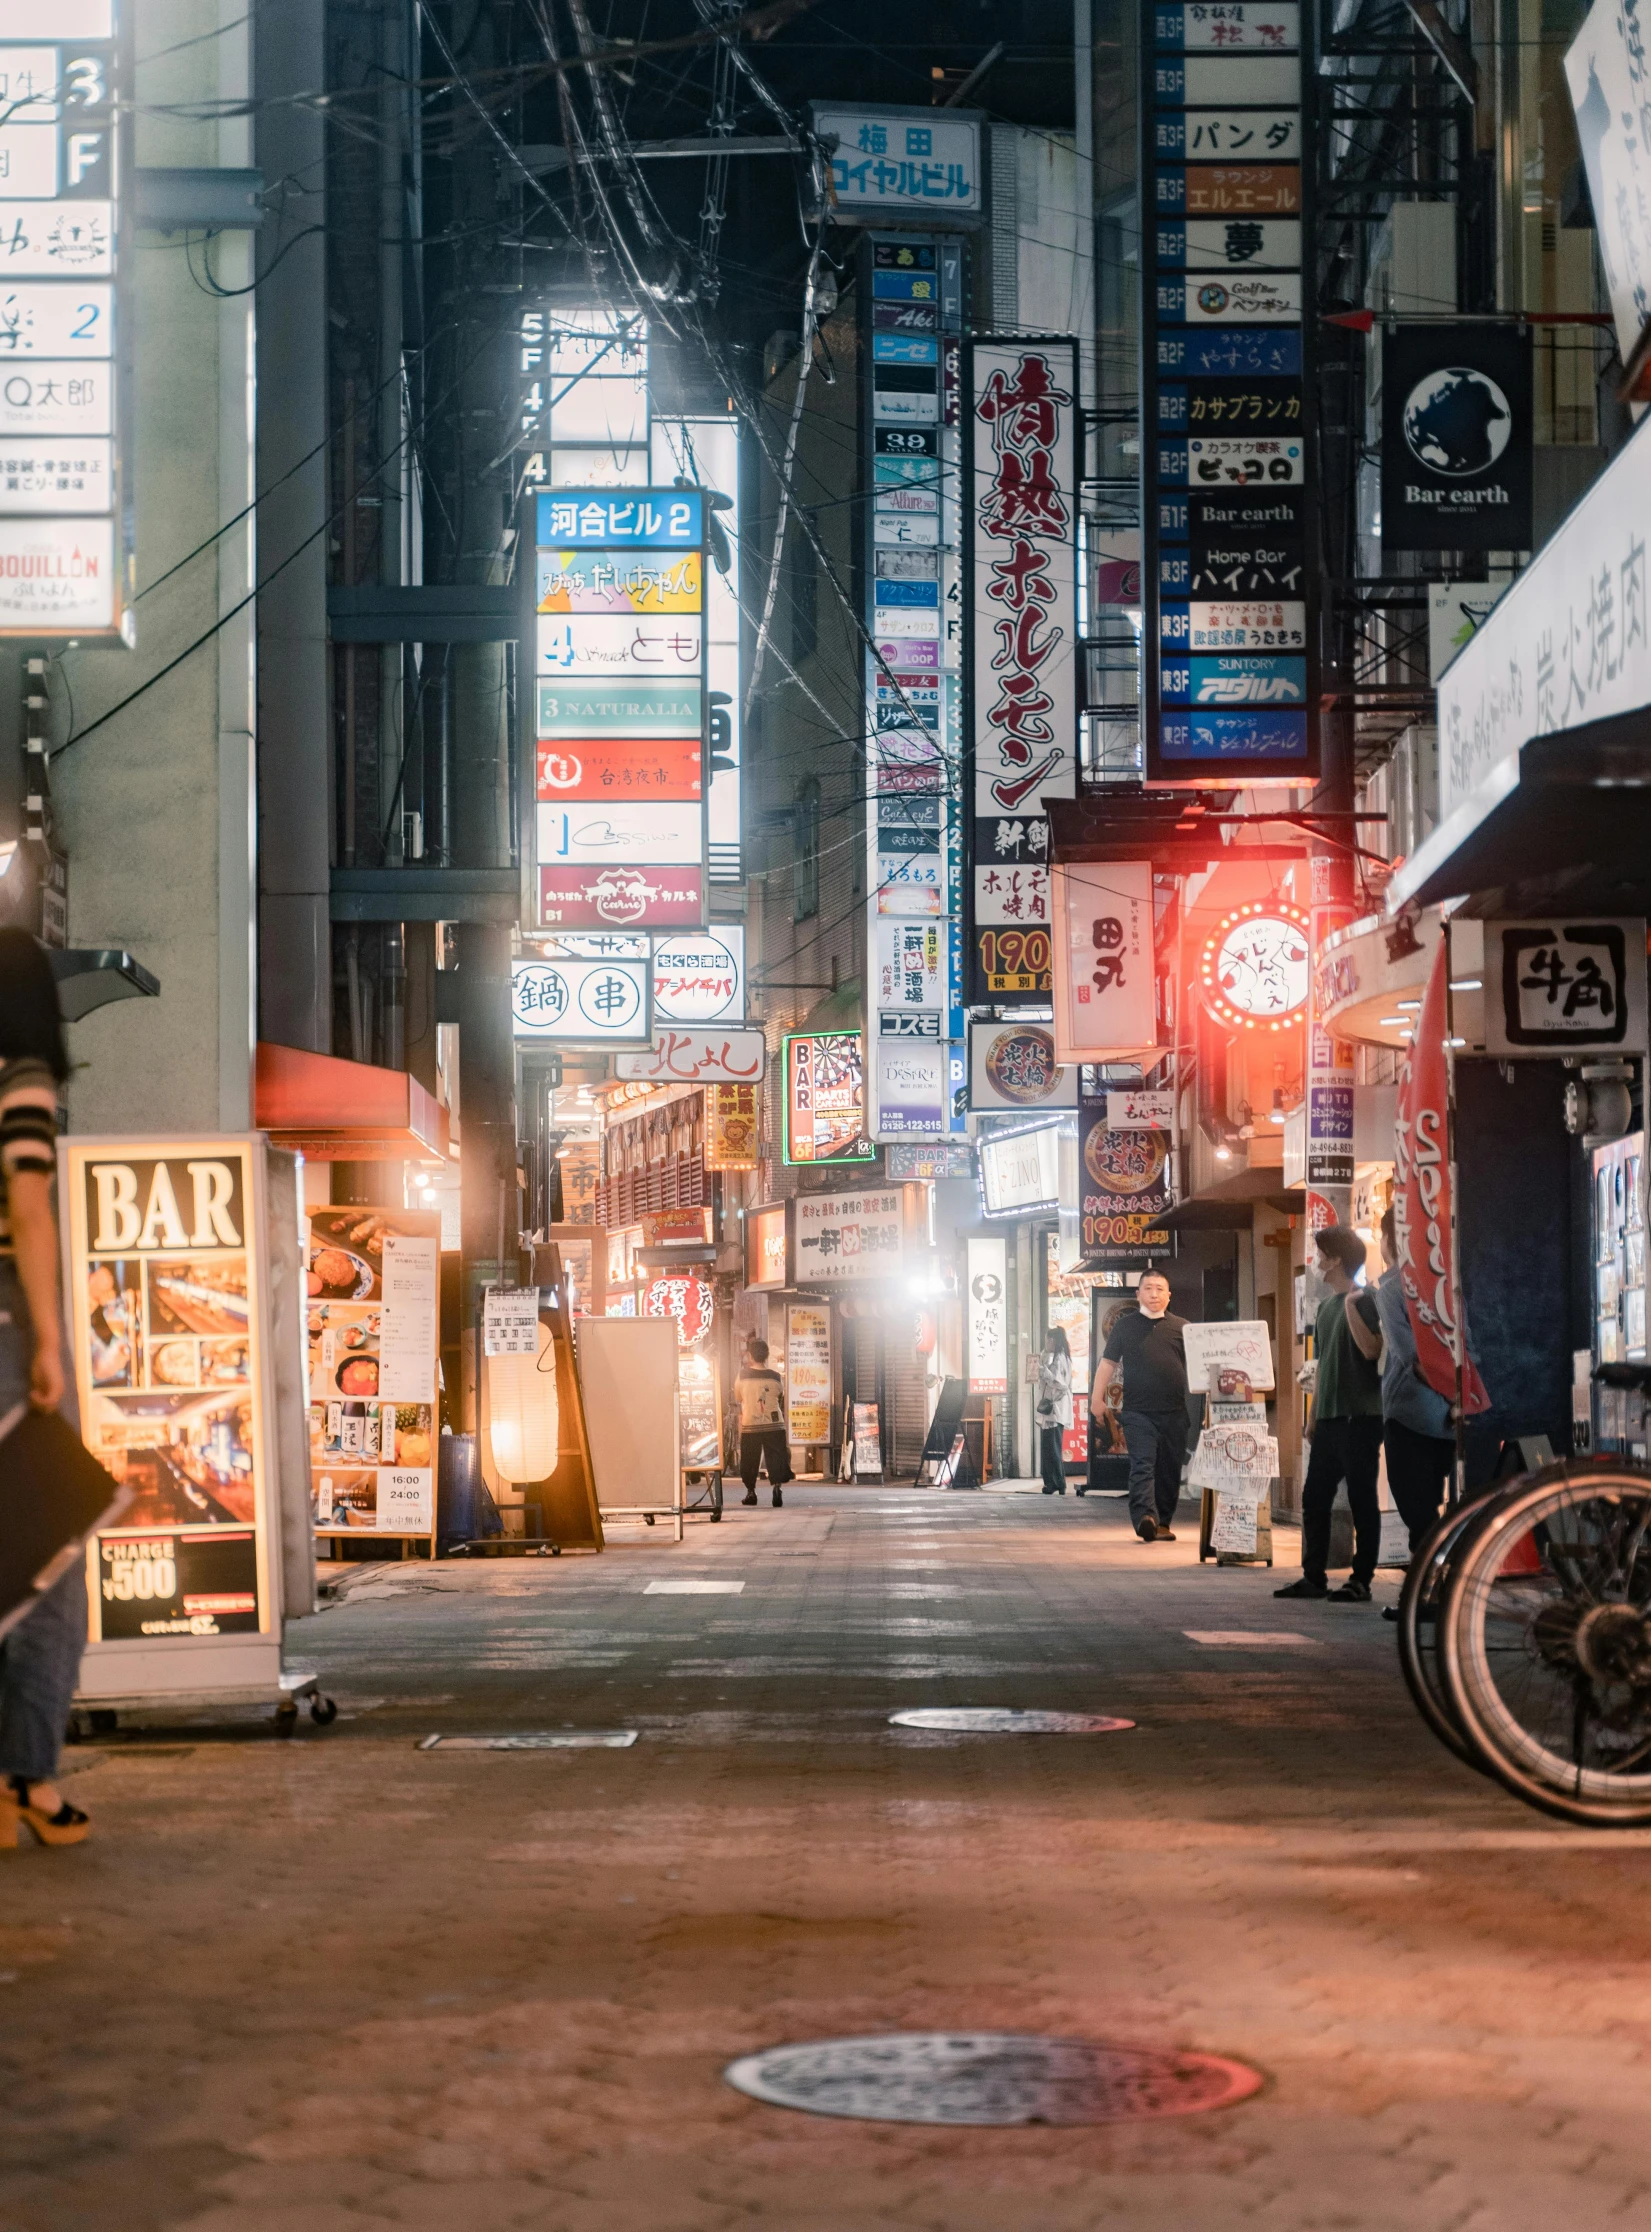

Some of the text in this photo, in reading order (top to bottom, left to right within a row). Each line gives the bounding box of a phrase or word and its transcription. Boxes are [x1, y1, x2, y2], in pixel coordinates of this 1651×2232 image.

[859, 124, 932, 156] 梅田
[1193, 122, 1293, 149] パンダ
[1213, 171, 1272, 183] ラウンジ
[1190, 188, 1296, 209] エルエール
[1225, 222, 1263, 262] 夢
[876, 247, 933, 267] こあら
[1232, 283, 1260, 296] Golf
[70, 303, 100, 339] 2
[895, 308, 934, 327] Aki
[1201, 349, 1287, 371] やすらぎ
[1191, 396, 1300, 420] カサブランカ
[887, 433, 926, 449] 39
[1208, 441, 1281, 454] カラオケ喫茶
[1405, 485, 1509, 503] Bar earth
[1203, 505, 1294, 521] Bar earth
[1208, 549, 1286, 565] Home Bar
[1161, 561, 1188, 583] 東3F
[1192, 566, 1301, 592] ハイハイ
[977, 354, 1071, 812] 情熱ホルモン
[1162, 615, 1189, 637] 東3F
[631, 627, 700, 662] とも
[906, 655, 934, 664] LOOP
[1218, 659, 1276, 670] SUNTORY
[1162, 670, 1189, 692] 東3F
[1197, 672, 1299, 701] アダルト
[545, 698, 693, 718] 3 NATURALIA
[1163, 726, 1188, 744] 東2F
[600, 768, 669, 786] 台湾夜市
[888, 868, 936, 882] もろもろ
[602, 899, 642, 910] carne
[661, 890, 698, 902] カルネ
[546, 910, 562, 921] B1
[1002, 895, 1046, 920] 焼肉
[658, 955, 728, 968] もぐら酒場
[904, 926, 924, 1003] 一軒め酒場
[1252, 938, 1284, 1008] じんべえ
[1520, 949, 1614, 1017] 牛角
[518, 974, 626, 1019] 鍋 串
[882, 1014, 939, 1035] コスモ
[795, 1043, 812, 1111] BAR
[815, 1089, 850, 1100] DARTS
[882, 1121, 942, 1131] 0120-122-515
[795, 1144, 812, 1158] 6F
[917, 1149, 946, 1160] BAR
[919, 1163, 933, 1177] 6F
[92, 1161, 241, 1250] BAR
[392, 1475, 420, 1484] 16:00
[390, 1490, 420, 1500] 24:00
[386, 1515, 424, 1527] 年中無休
[101, 1543, 175, 1562] CHARGE
[102, 1558, 177, 1602] ¥500
